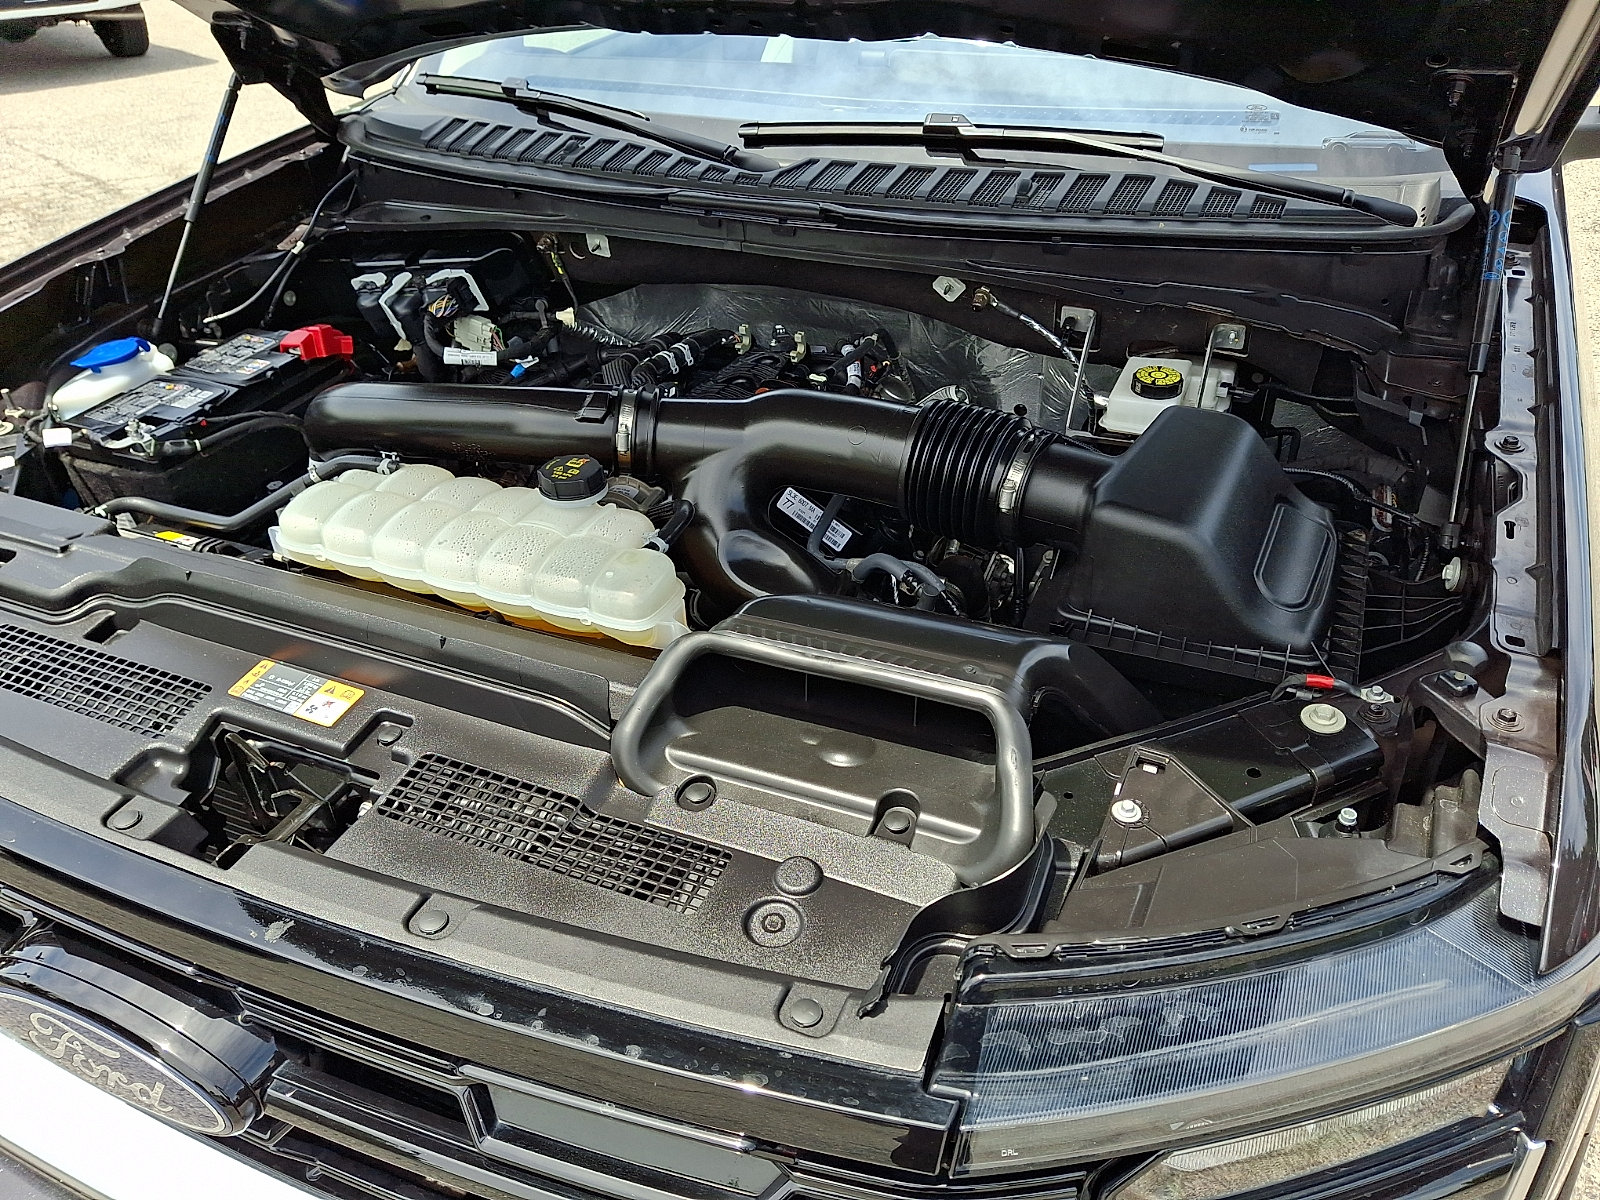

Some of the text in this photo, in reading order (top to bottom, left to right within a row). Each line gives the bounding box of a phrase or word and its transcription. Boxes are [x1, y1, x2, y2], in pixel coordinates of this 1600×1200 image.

[783, 497, 795, 510] 77
[29, 1012, 174, 1113] Ford
[1001, 1148, 1019, 1157] DRL
